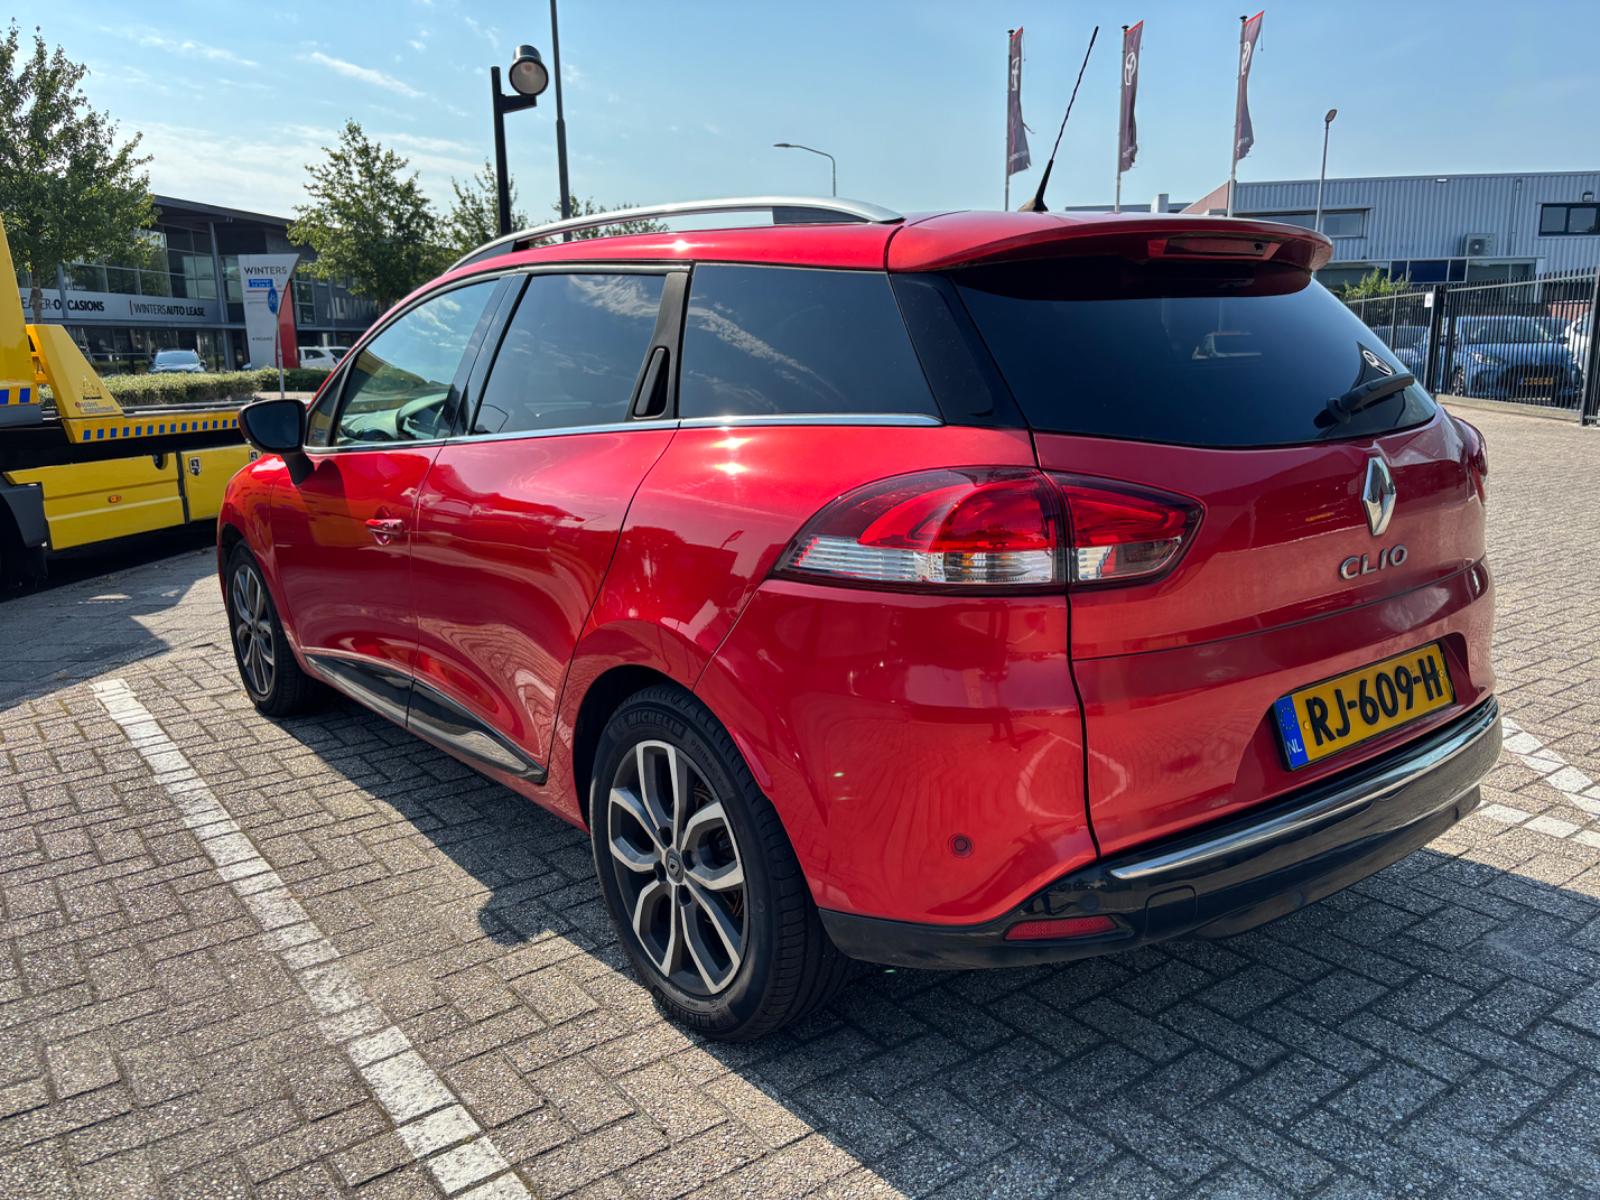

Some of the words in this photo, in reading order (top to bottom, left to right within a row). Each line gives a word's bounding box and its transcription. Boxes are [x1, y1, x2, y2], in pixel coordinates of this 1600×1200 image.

[243, 265, 287, 275] WINTERS
[1339, 543, 1408, 581] CLIO
[1305, 655, 1443, 746] RJ-609-H
[1286, 738, 1303, 755] NL
